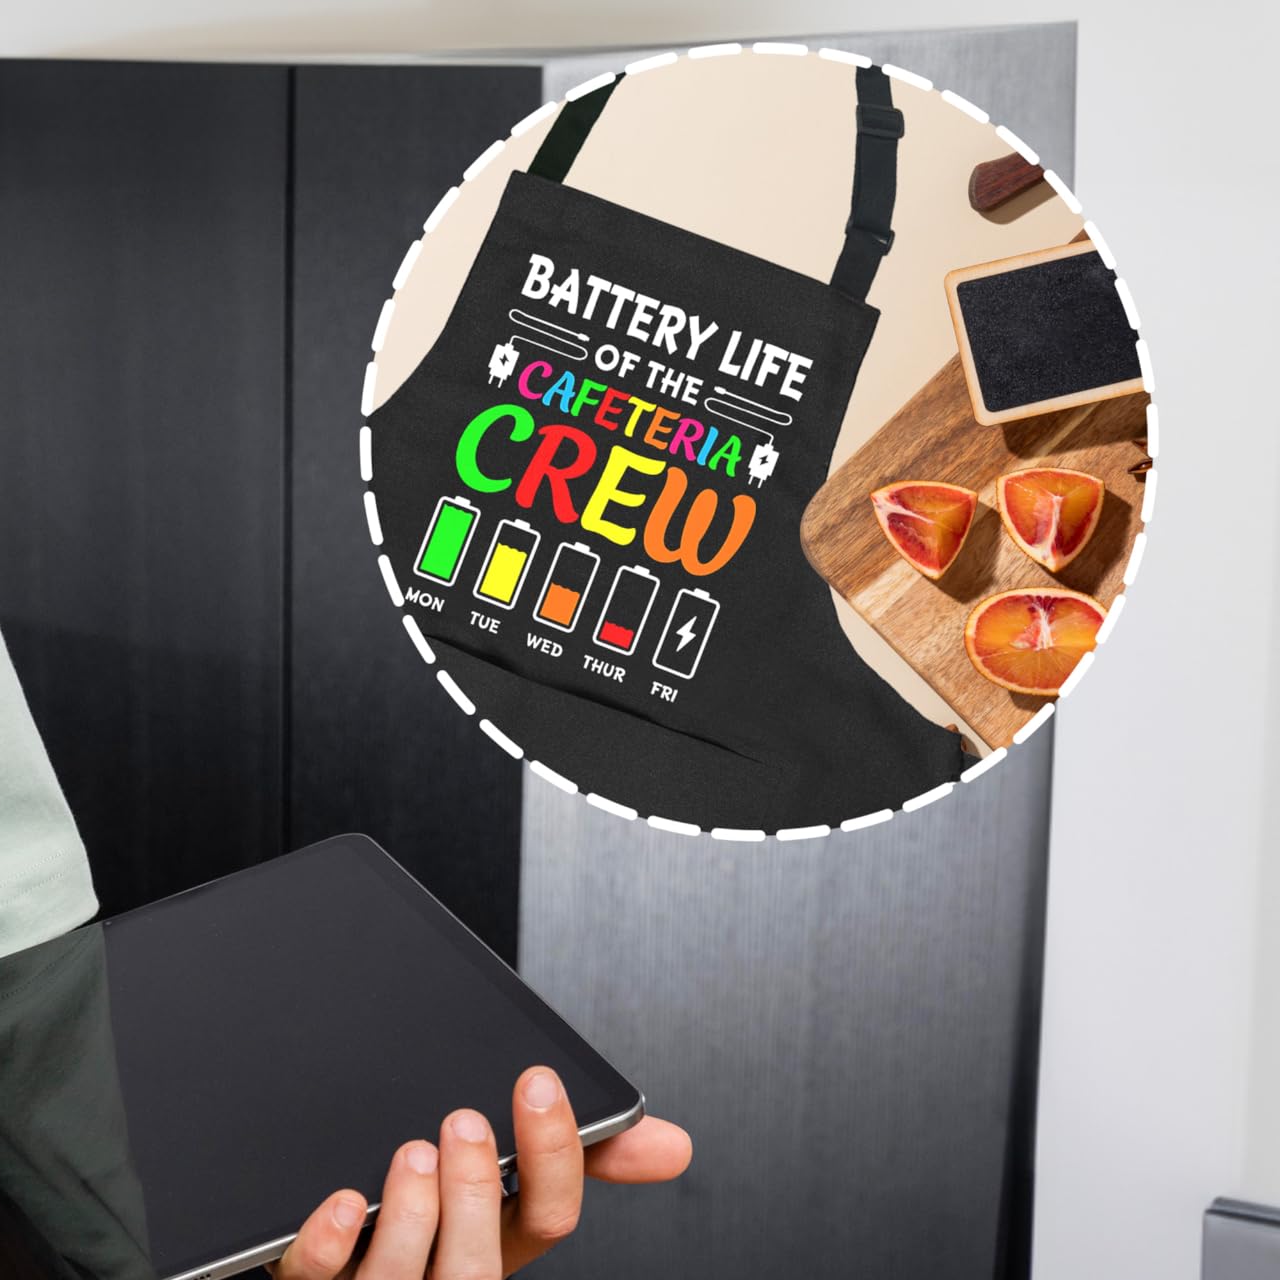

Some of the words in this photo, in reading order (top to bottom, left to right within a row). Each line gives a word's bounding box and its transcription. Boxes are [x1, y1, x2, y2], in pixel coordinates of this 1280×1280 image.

[521, 254, 719, 361] BATTERY
[718, 330, 814, 402] LIFE
[595, 344, 642, 378] OF
[646, 360, 704, 405] THE
[517, 360, 742, 478] CAFETERIA
[455, 403, 757, 577] CREW
[405, 586, 445, 612] MON
[470, 610, 501, 634] TUE
[526, 632, 563, 658] WED
[583, 654, 626, 682] THUR
[650, 681, 679, 703] FRI
